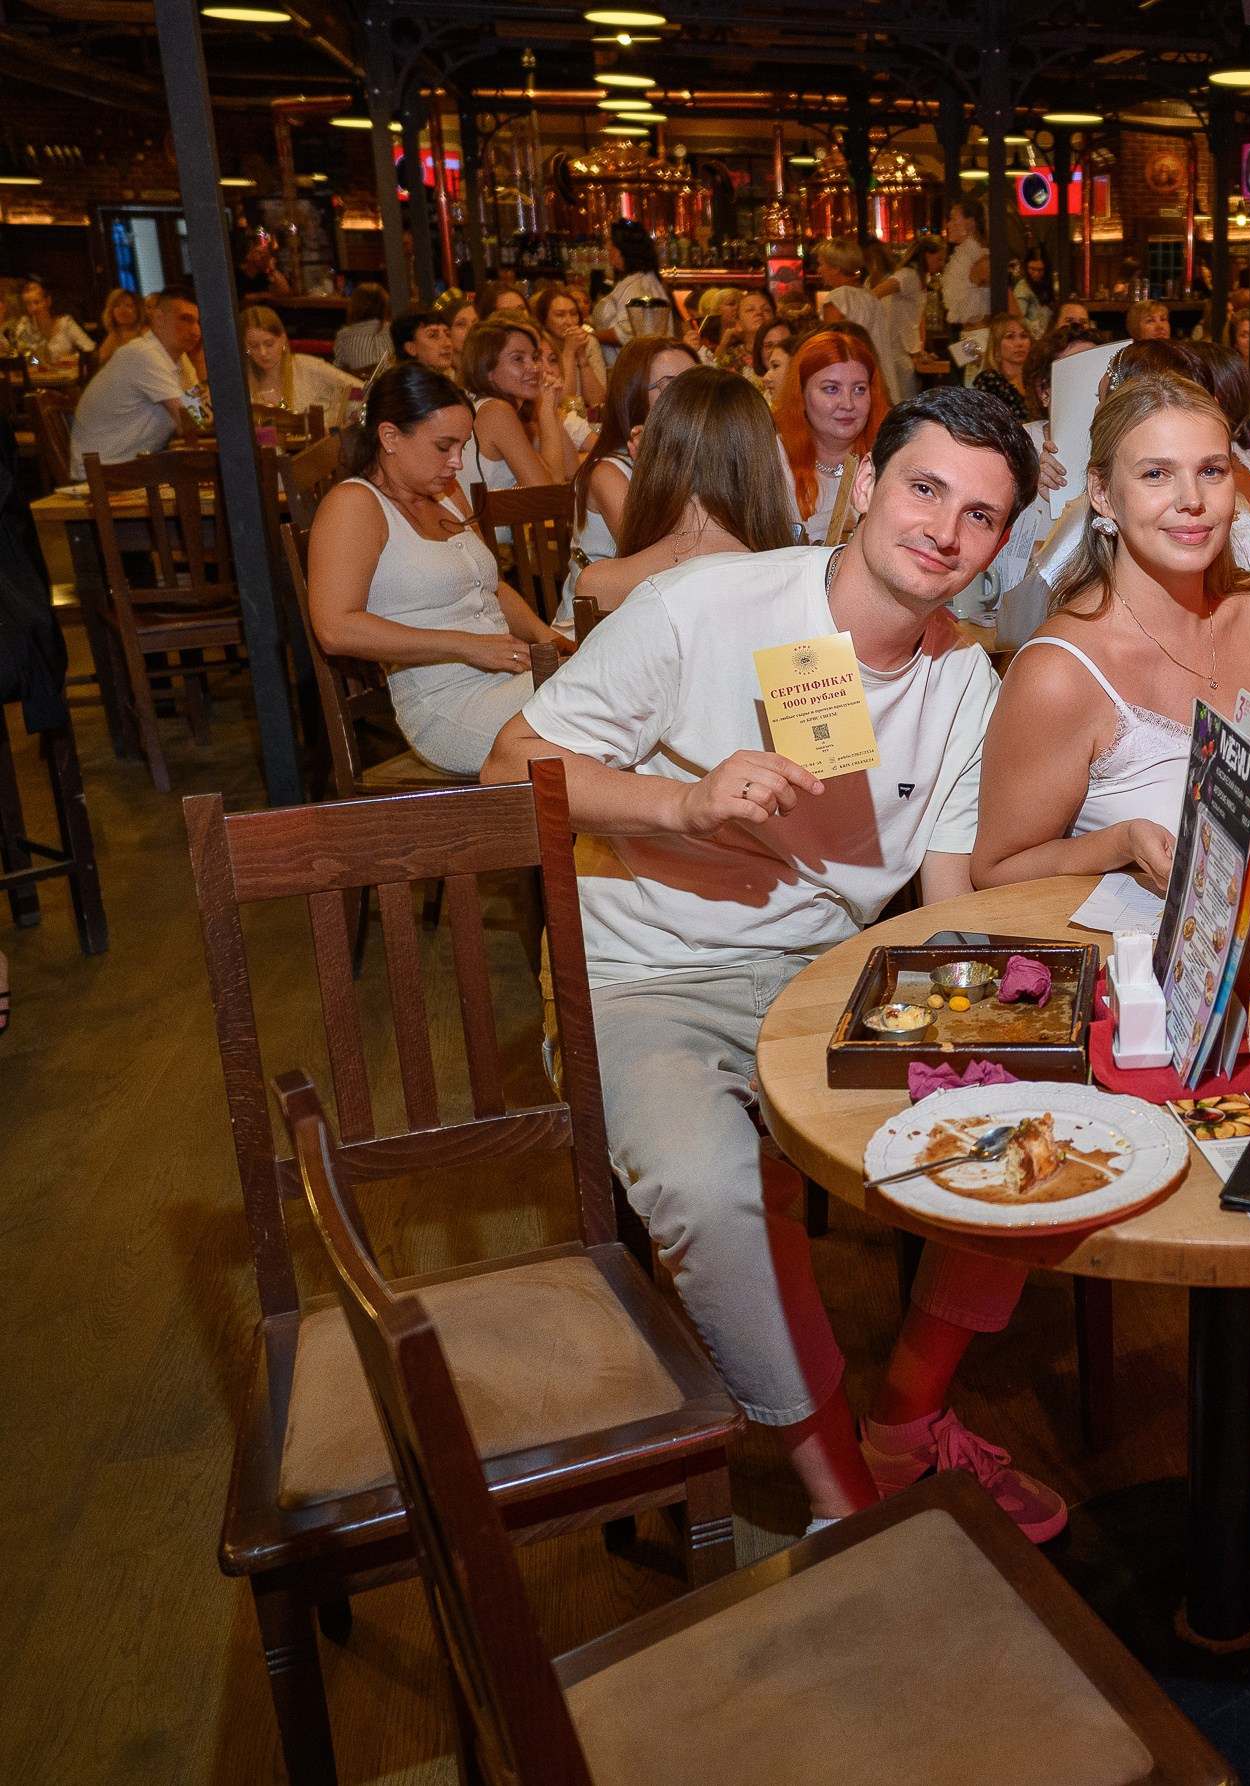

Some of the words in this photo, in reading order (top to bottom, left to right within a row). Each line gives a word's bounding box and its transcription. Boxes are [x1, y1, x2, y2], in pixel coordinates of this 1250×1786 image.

[770, 672, 854, 699] СЕРТИФИКАТ
[782, 697, 807, 710] 1000
[810, 688, 847, 706] рублей
